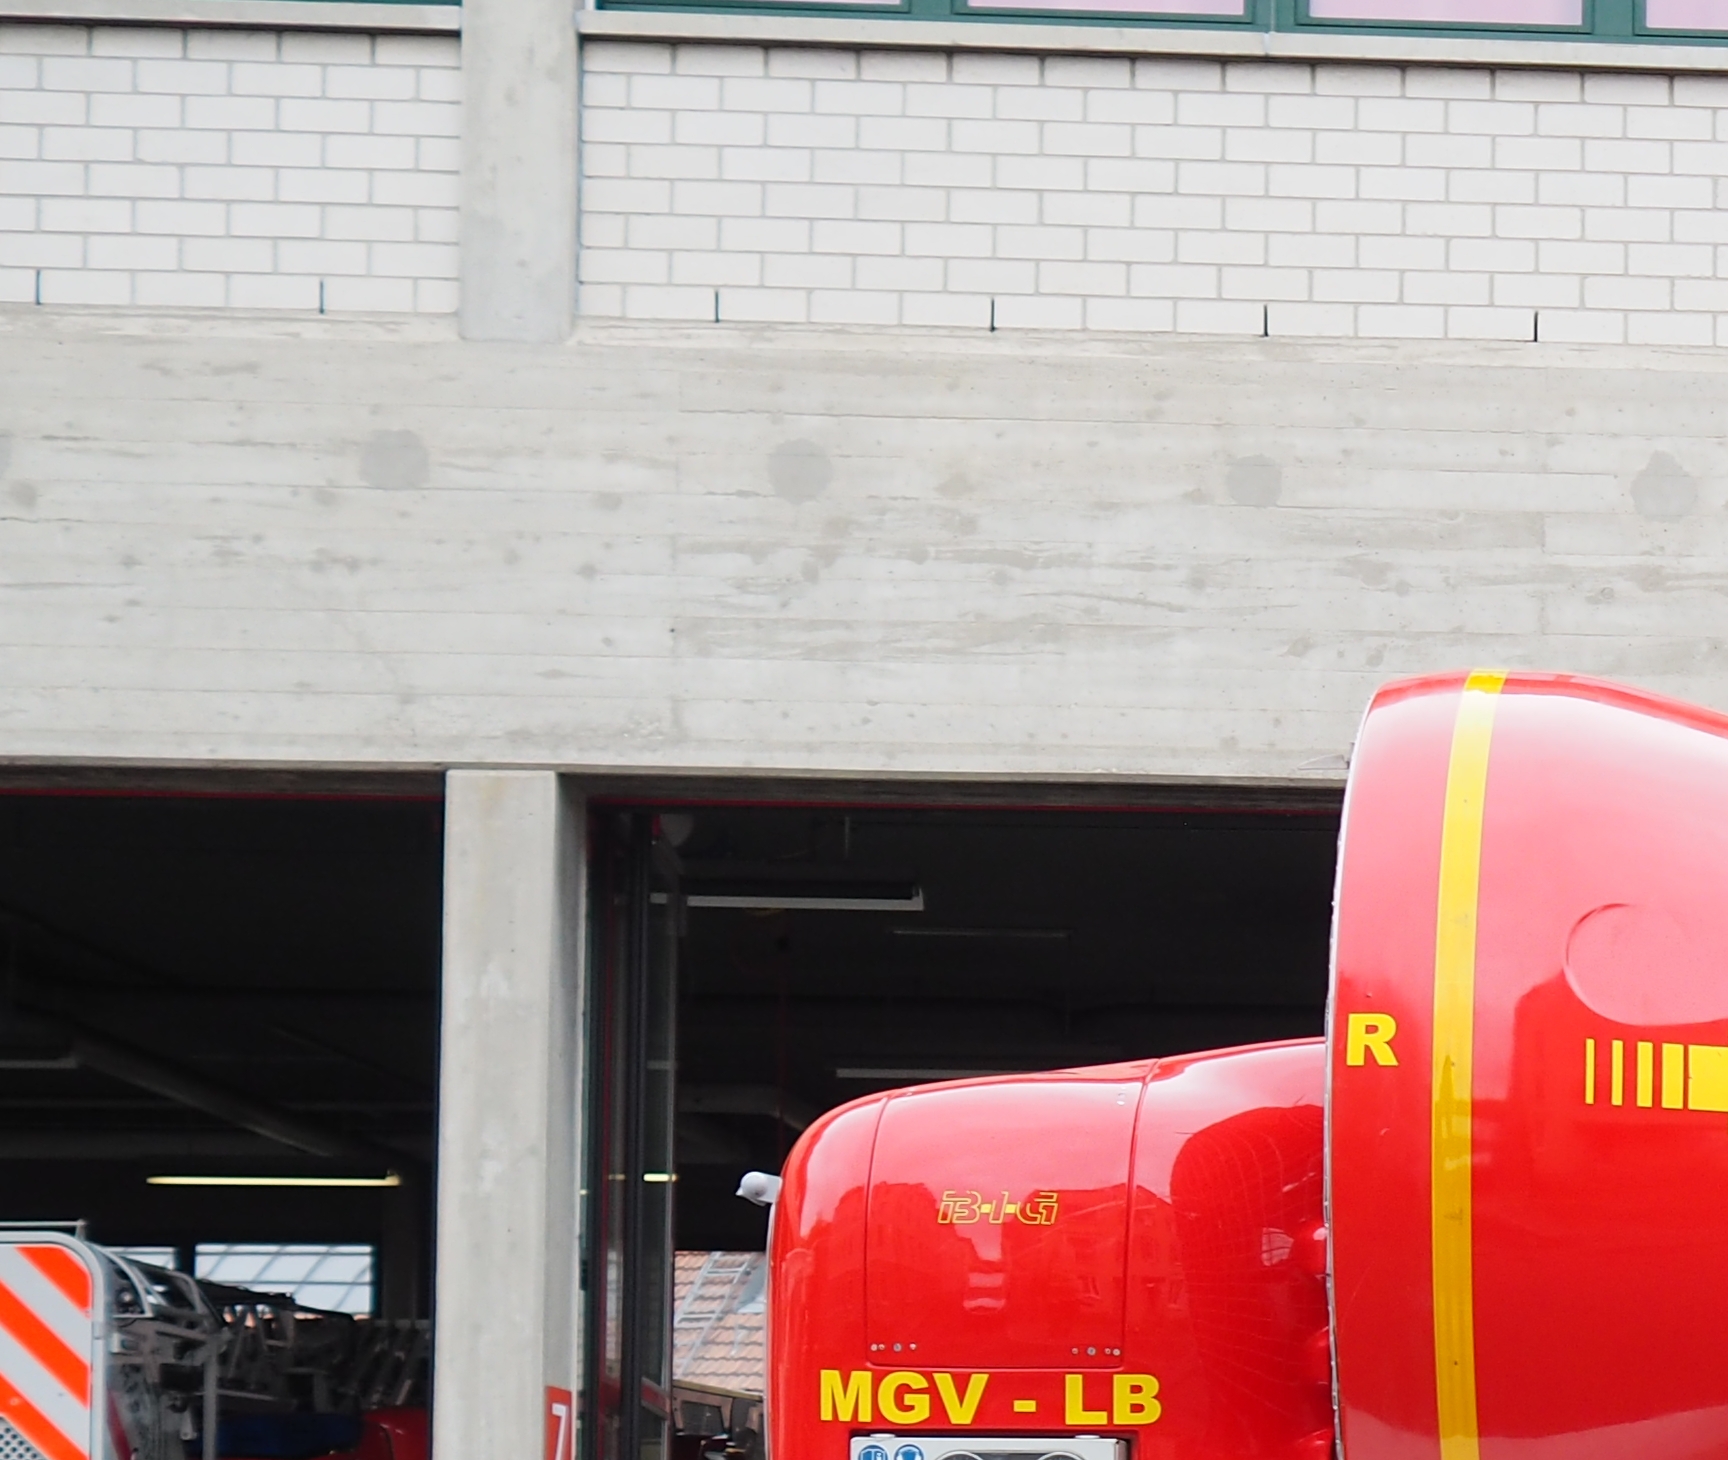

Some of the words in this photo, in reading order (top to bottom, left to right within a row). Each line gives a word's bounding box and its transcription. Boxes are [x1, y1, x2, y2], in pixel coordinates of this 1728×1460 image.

[1346, 1013, 1399, 1066] R
[820, 1369, 989, 1425] MGV
[1013, 1399, 1037, 1413] -
[1065, 1374, 1162, 1425] LB
